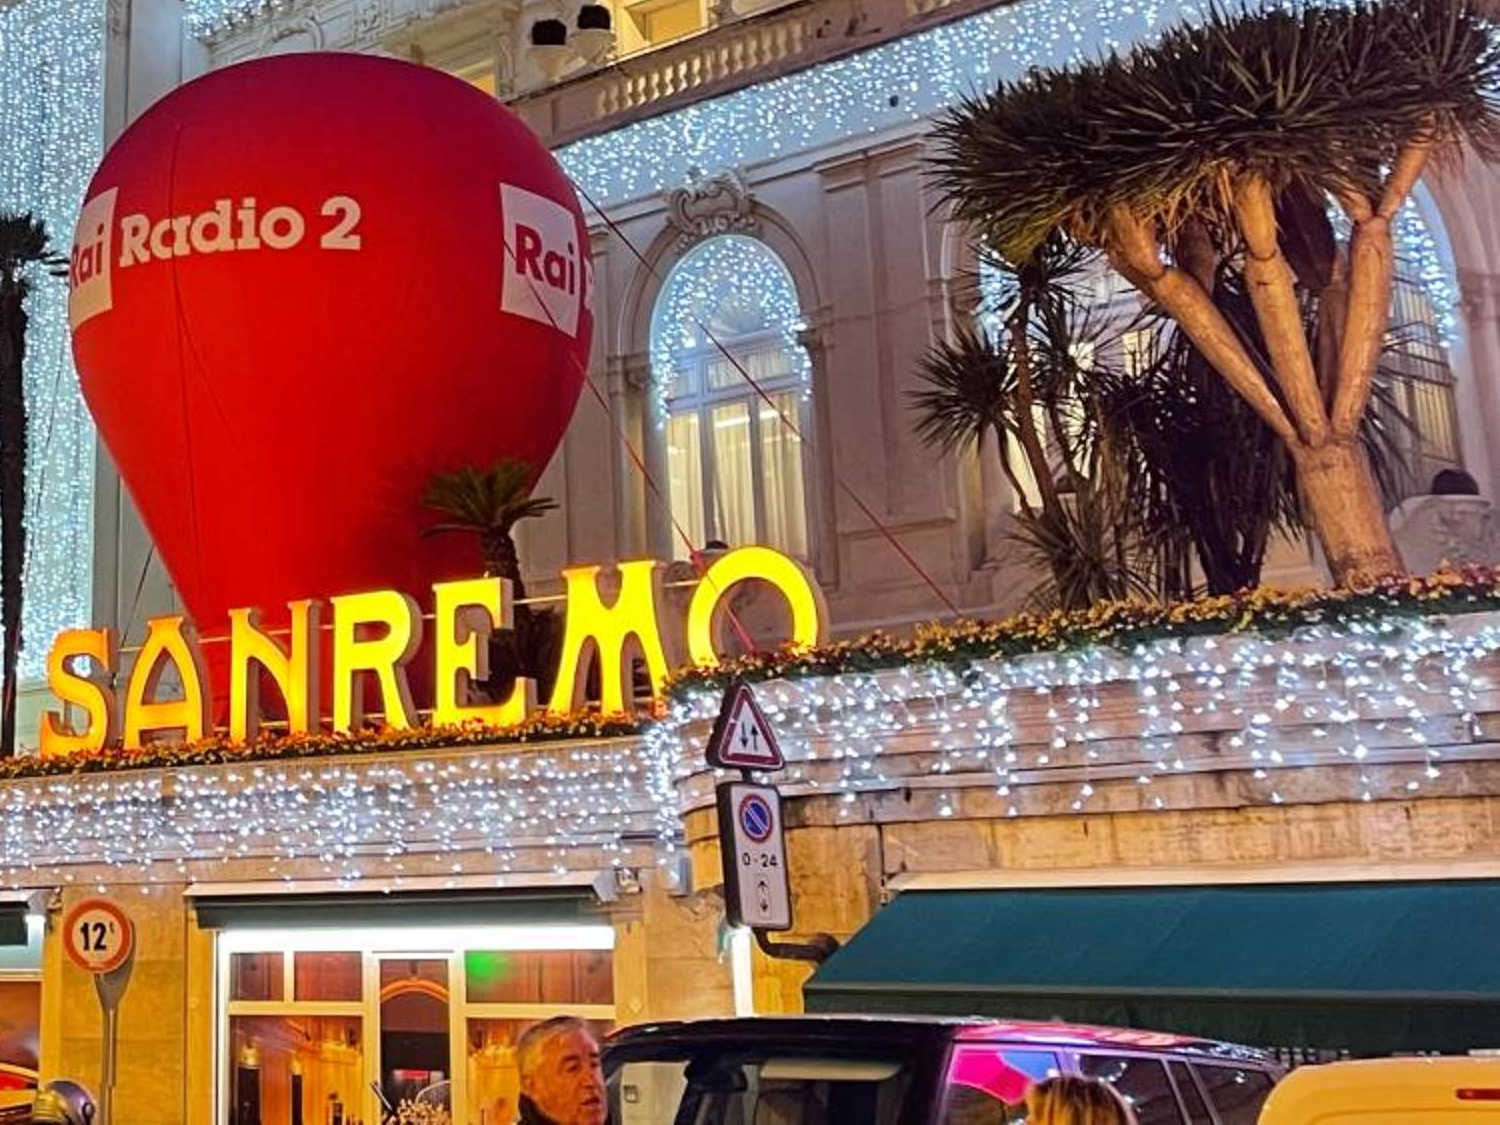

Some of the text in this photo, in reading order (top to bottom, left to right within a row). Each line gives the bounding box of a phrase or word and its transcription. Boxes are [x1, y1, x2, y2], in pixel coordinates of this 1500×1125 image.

[119, 197, 305, 268] Radio
[320, 195, 361, 251] 2
[515, 223, 575, 295] Rai
[40, 546, 820, 758] SANREMO
